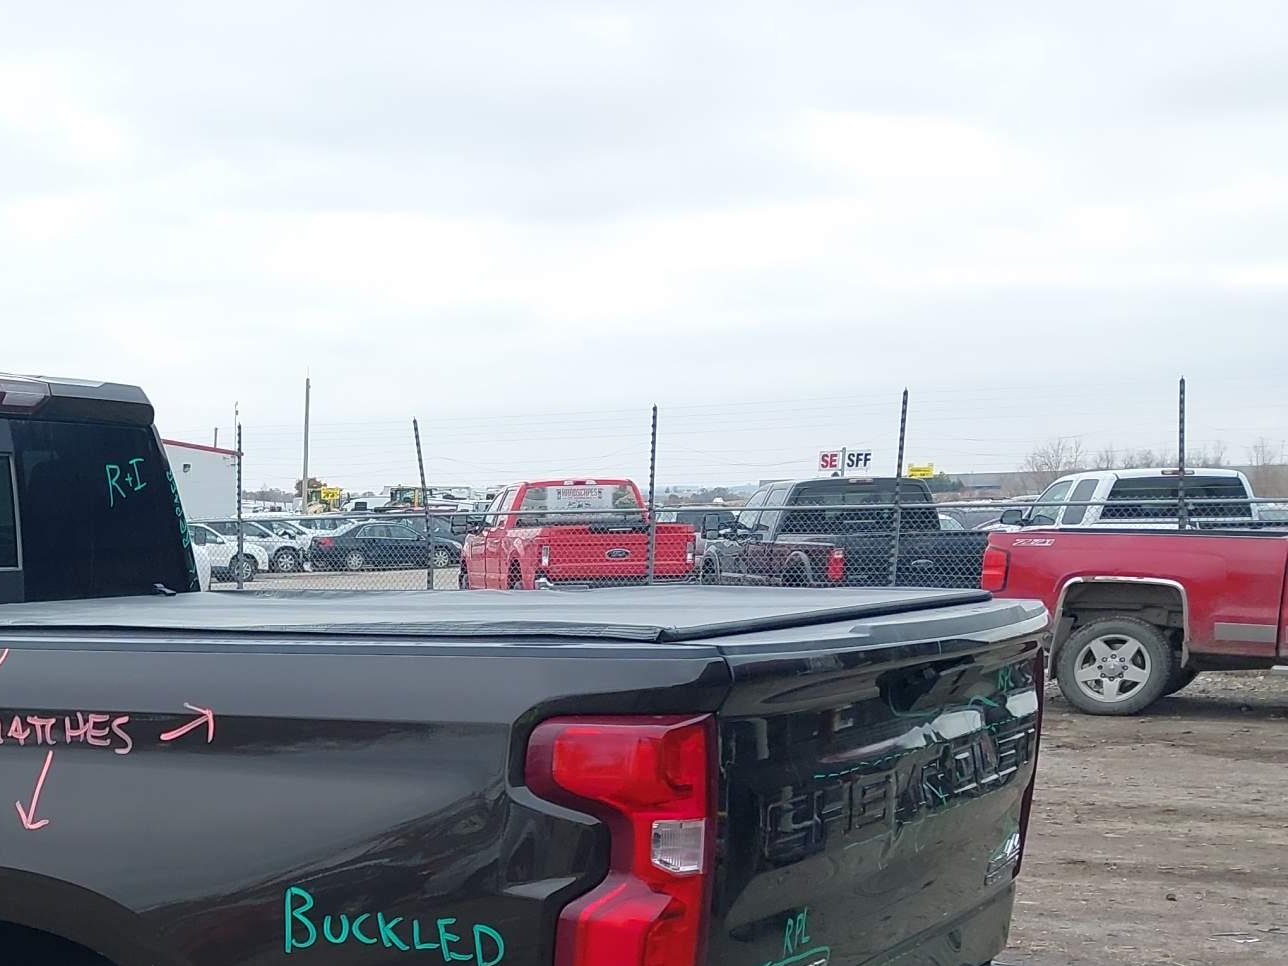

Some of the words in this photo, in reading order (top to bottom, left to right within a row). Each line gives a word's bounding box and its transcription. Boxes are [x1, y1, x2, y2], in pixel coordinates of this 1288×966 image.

[820, 453, 838, 468] SE
[846, 453, 872, 468] SFF
[782, 906, 811, 957] RPL
